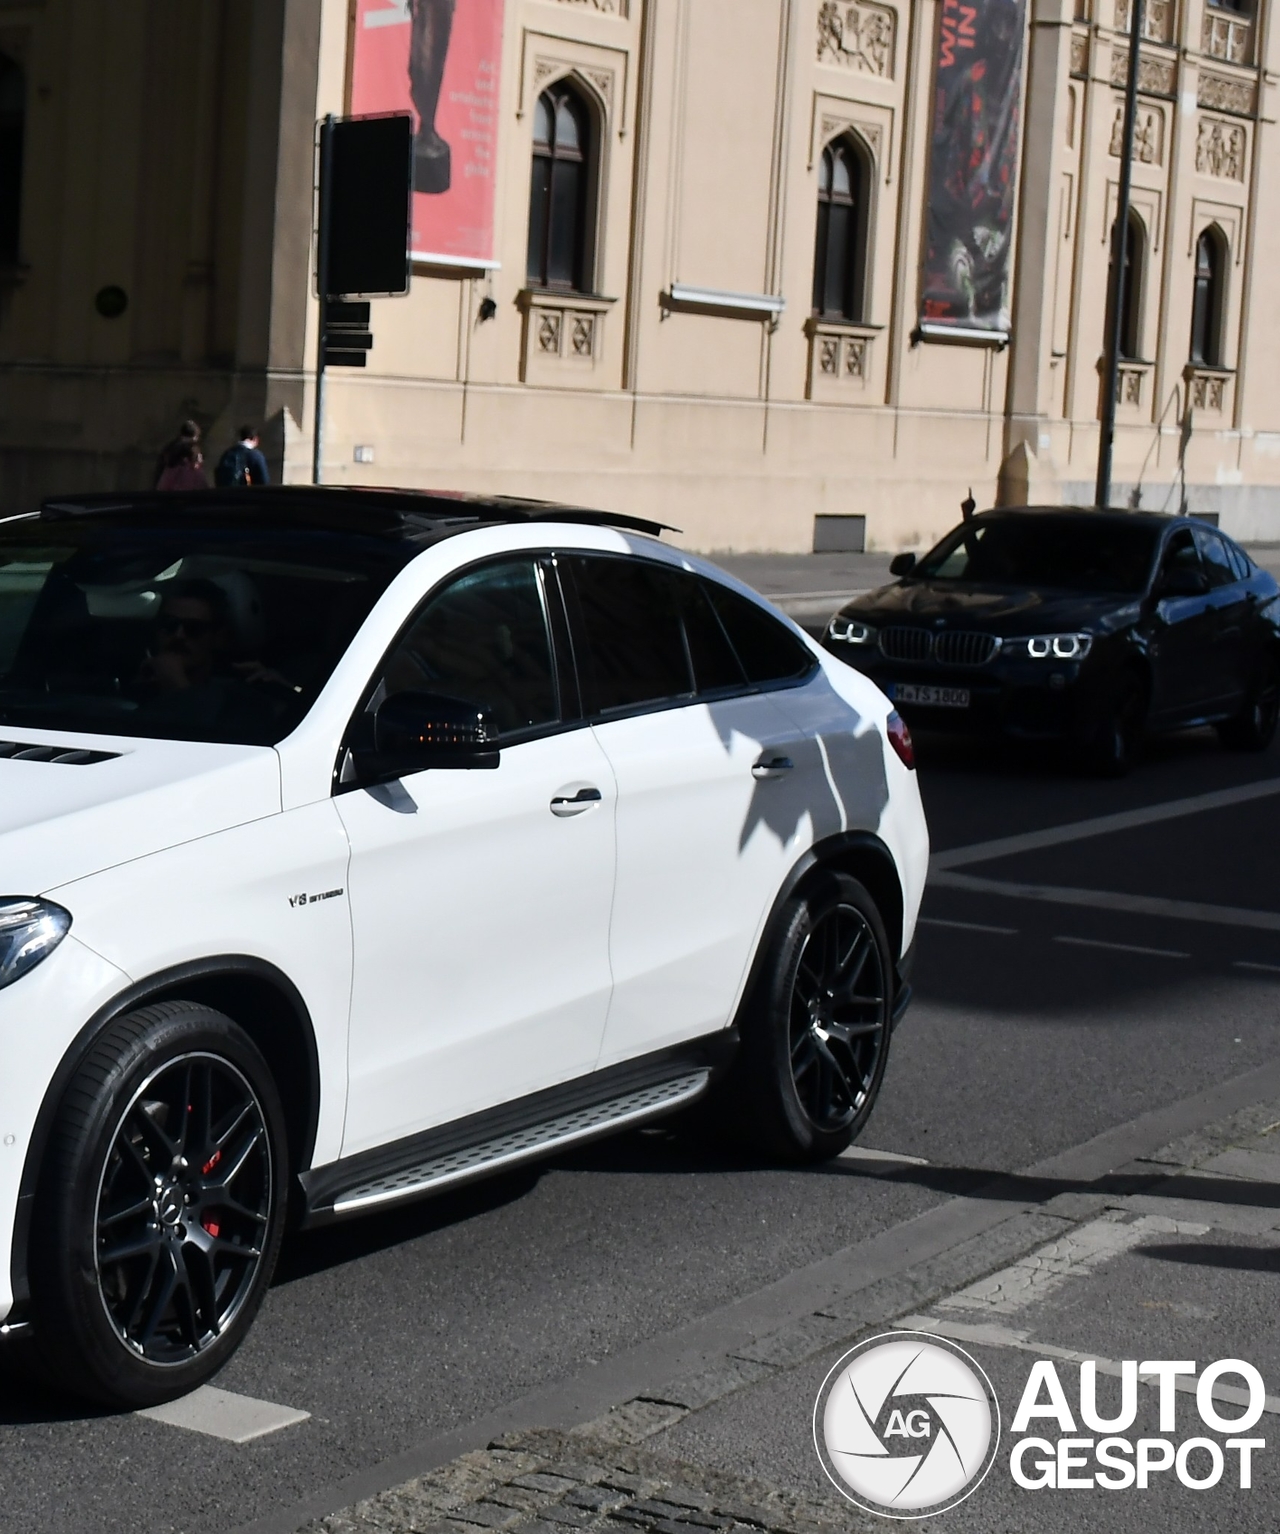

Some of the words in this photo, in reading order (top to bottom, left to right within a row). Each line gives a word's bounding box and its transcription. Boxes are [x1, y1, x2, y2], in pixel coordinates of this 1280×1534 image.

[958, 5, 977, 48] IN
[914, 686, 931, 701] TS
[288, 893, 306, 908] V8
